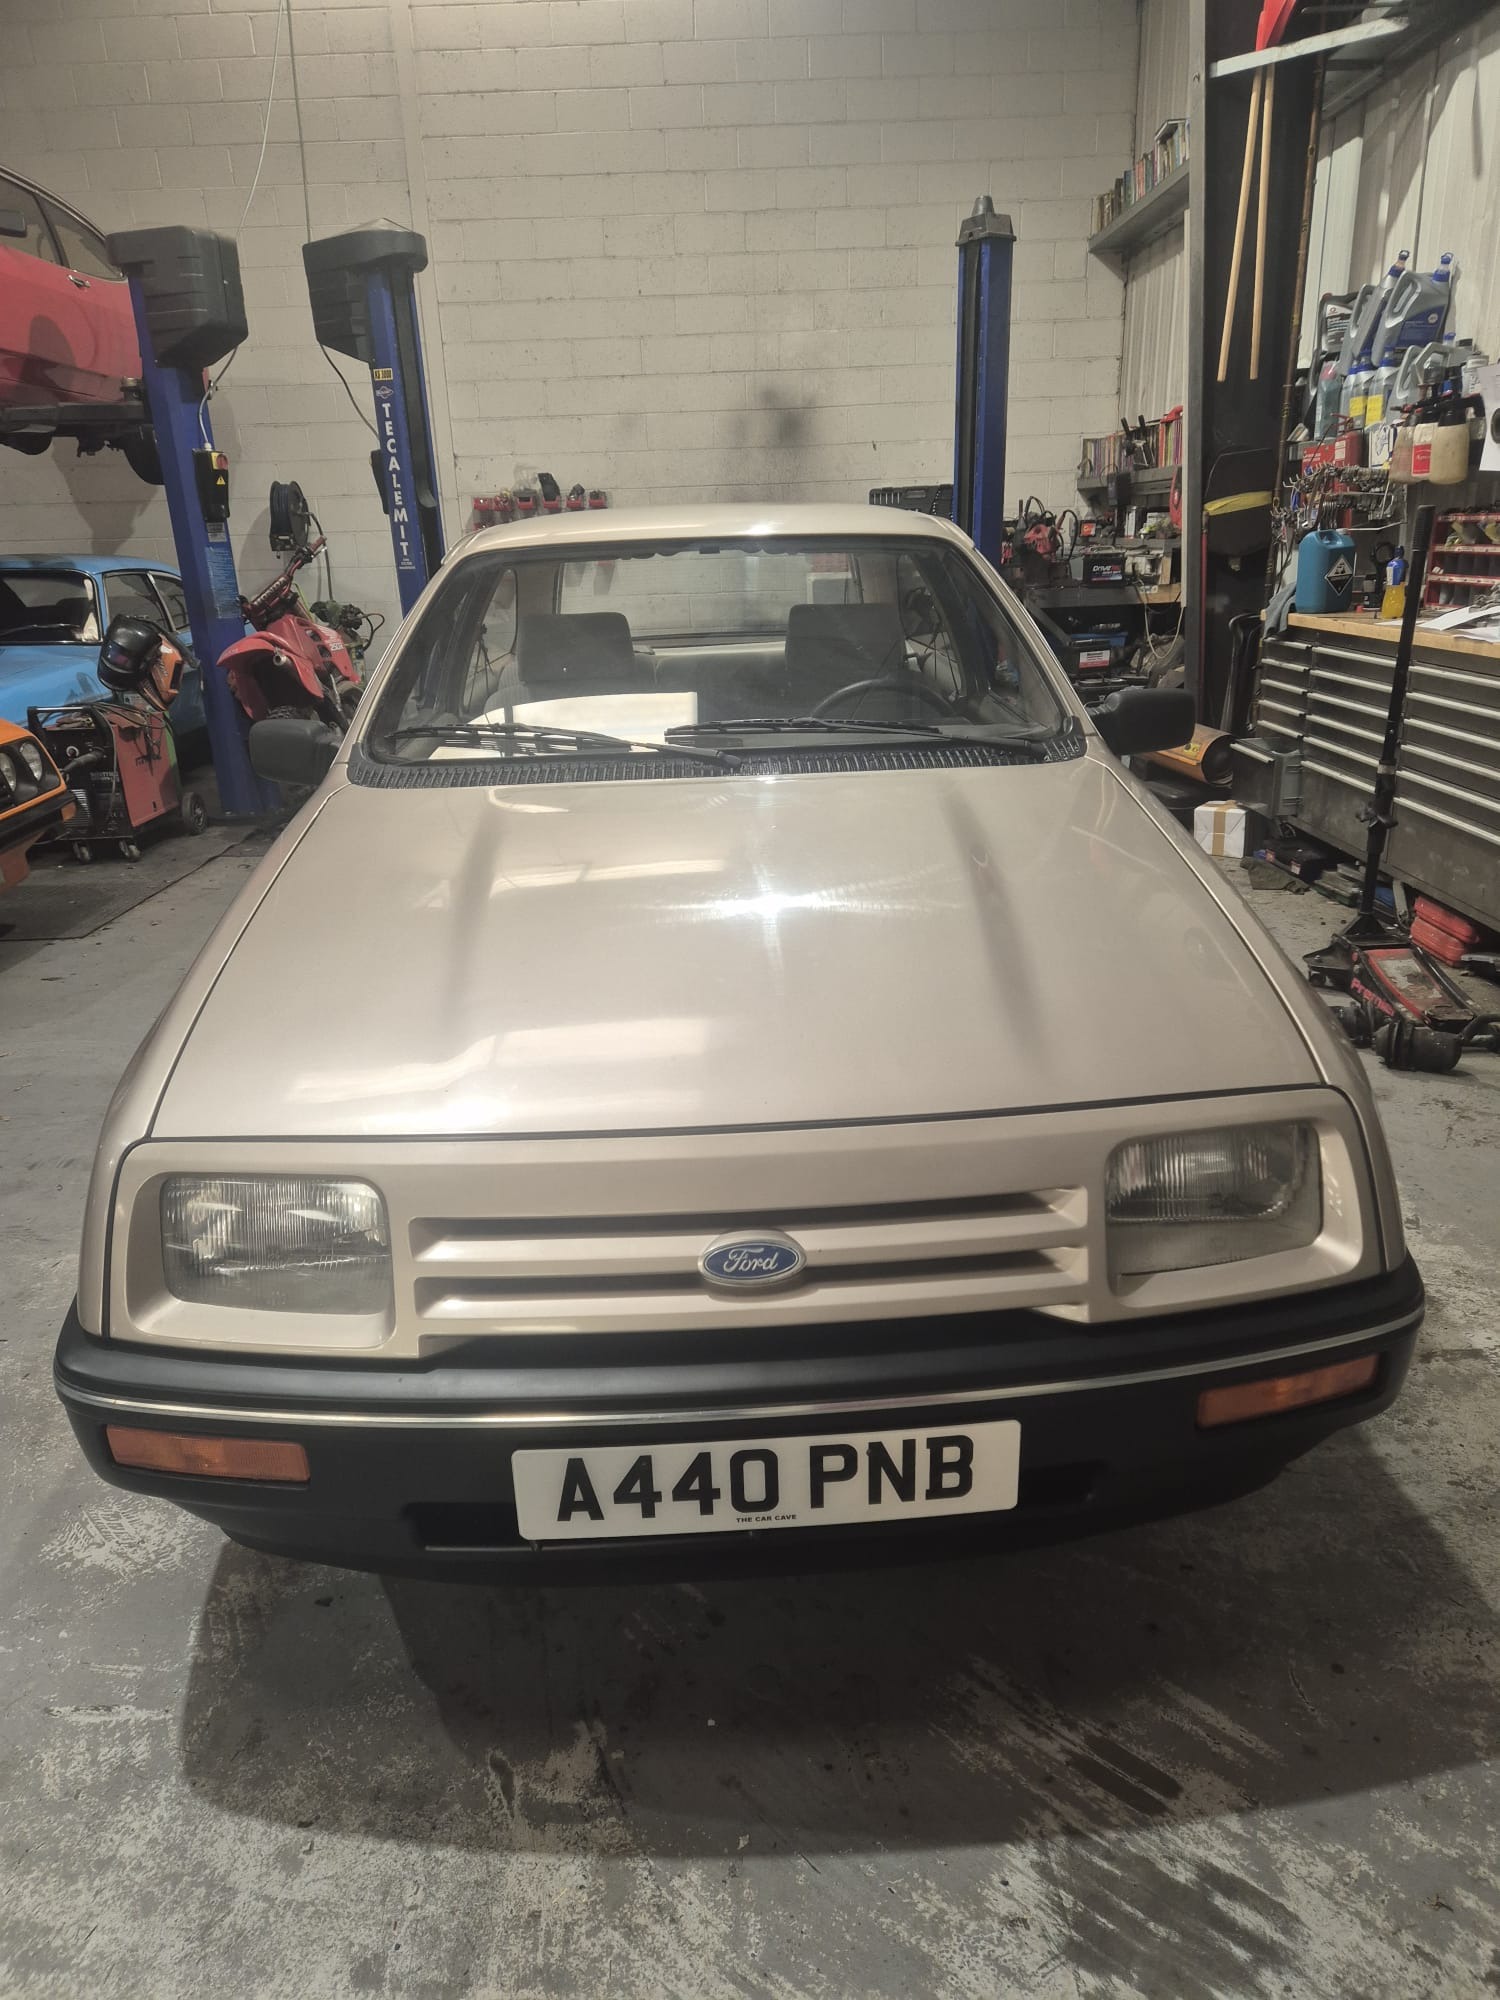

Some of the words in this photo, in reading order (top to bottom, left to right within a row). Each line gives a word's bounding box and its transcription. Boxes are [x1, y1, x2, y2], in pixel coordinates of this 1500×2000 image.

[381, 403, 409, 556] TECALEMIT
[723, 1247, 778, 1273] Ford
[556, 1448, 779, 1521] A440
[810, 1434, 974, 1509] PNB
